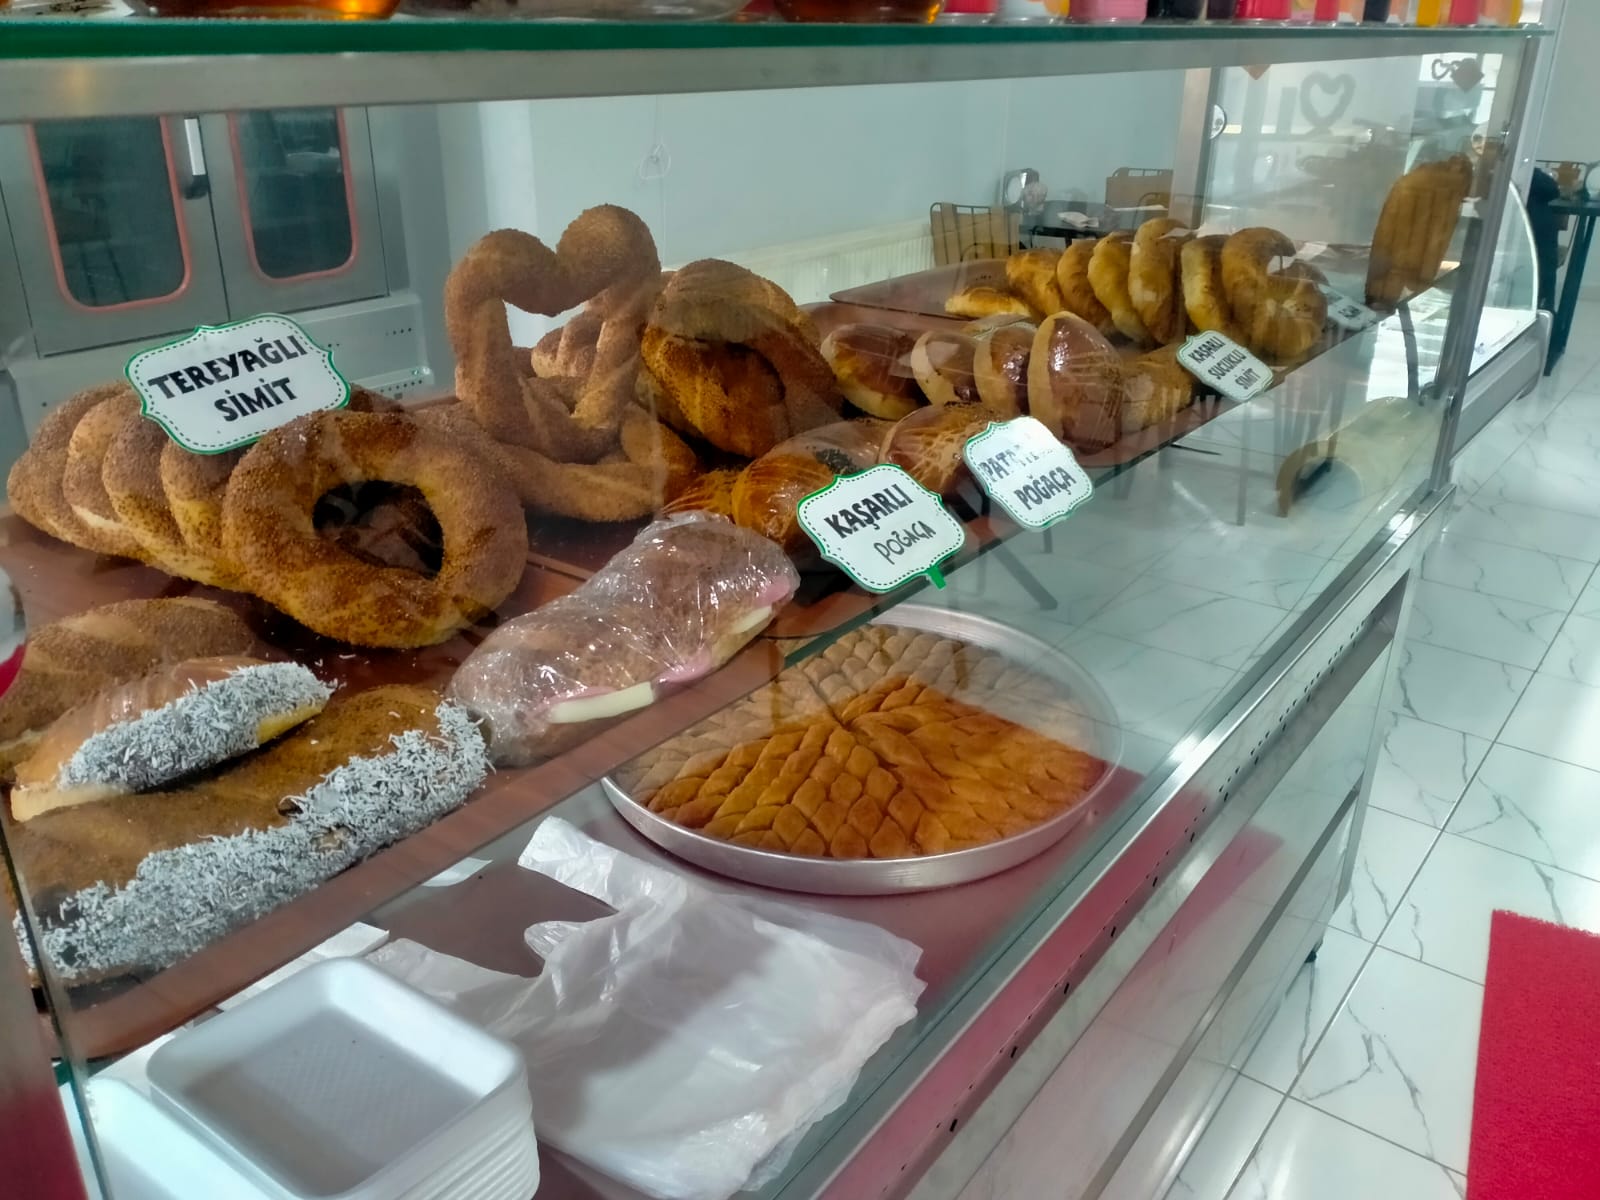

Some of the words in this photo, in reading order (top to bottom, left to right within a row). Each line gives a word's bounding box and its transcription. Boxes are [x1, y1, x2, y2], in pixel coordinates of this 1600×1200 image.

[147, 334, 309, 400] TEREYAĞLI
[1188, 336, 1226, 364] KAŞARLI
[1207, 349, 1247, 380] SUCUKLU
[213, 376, 298, 422] SİMİT
[823, 483, 914, 539] KAŞARLI
[1013, 466, 1077, 511] POĞAÇA
